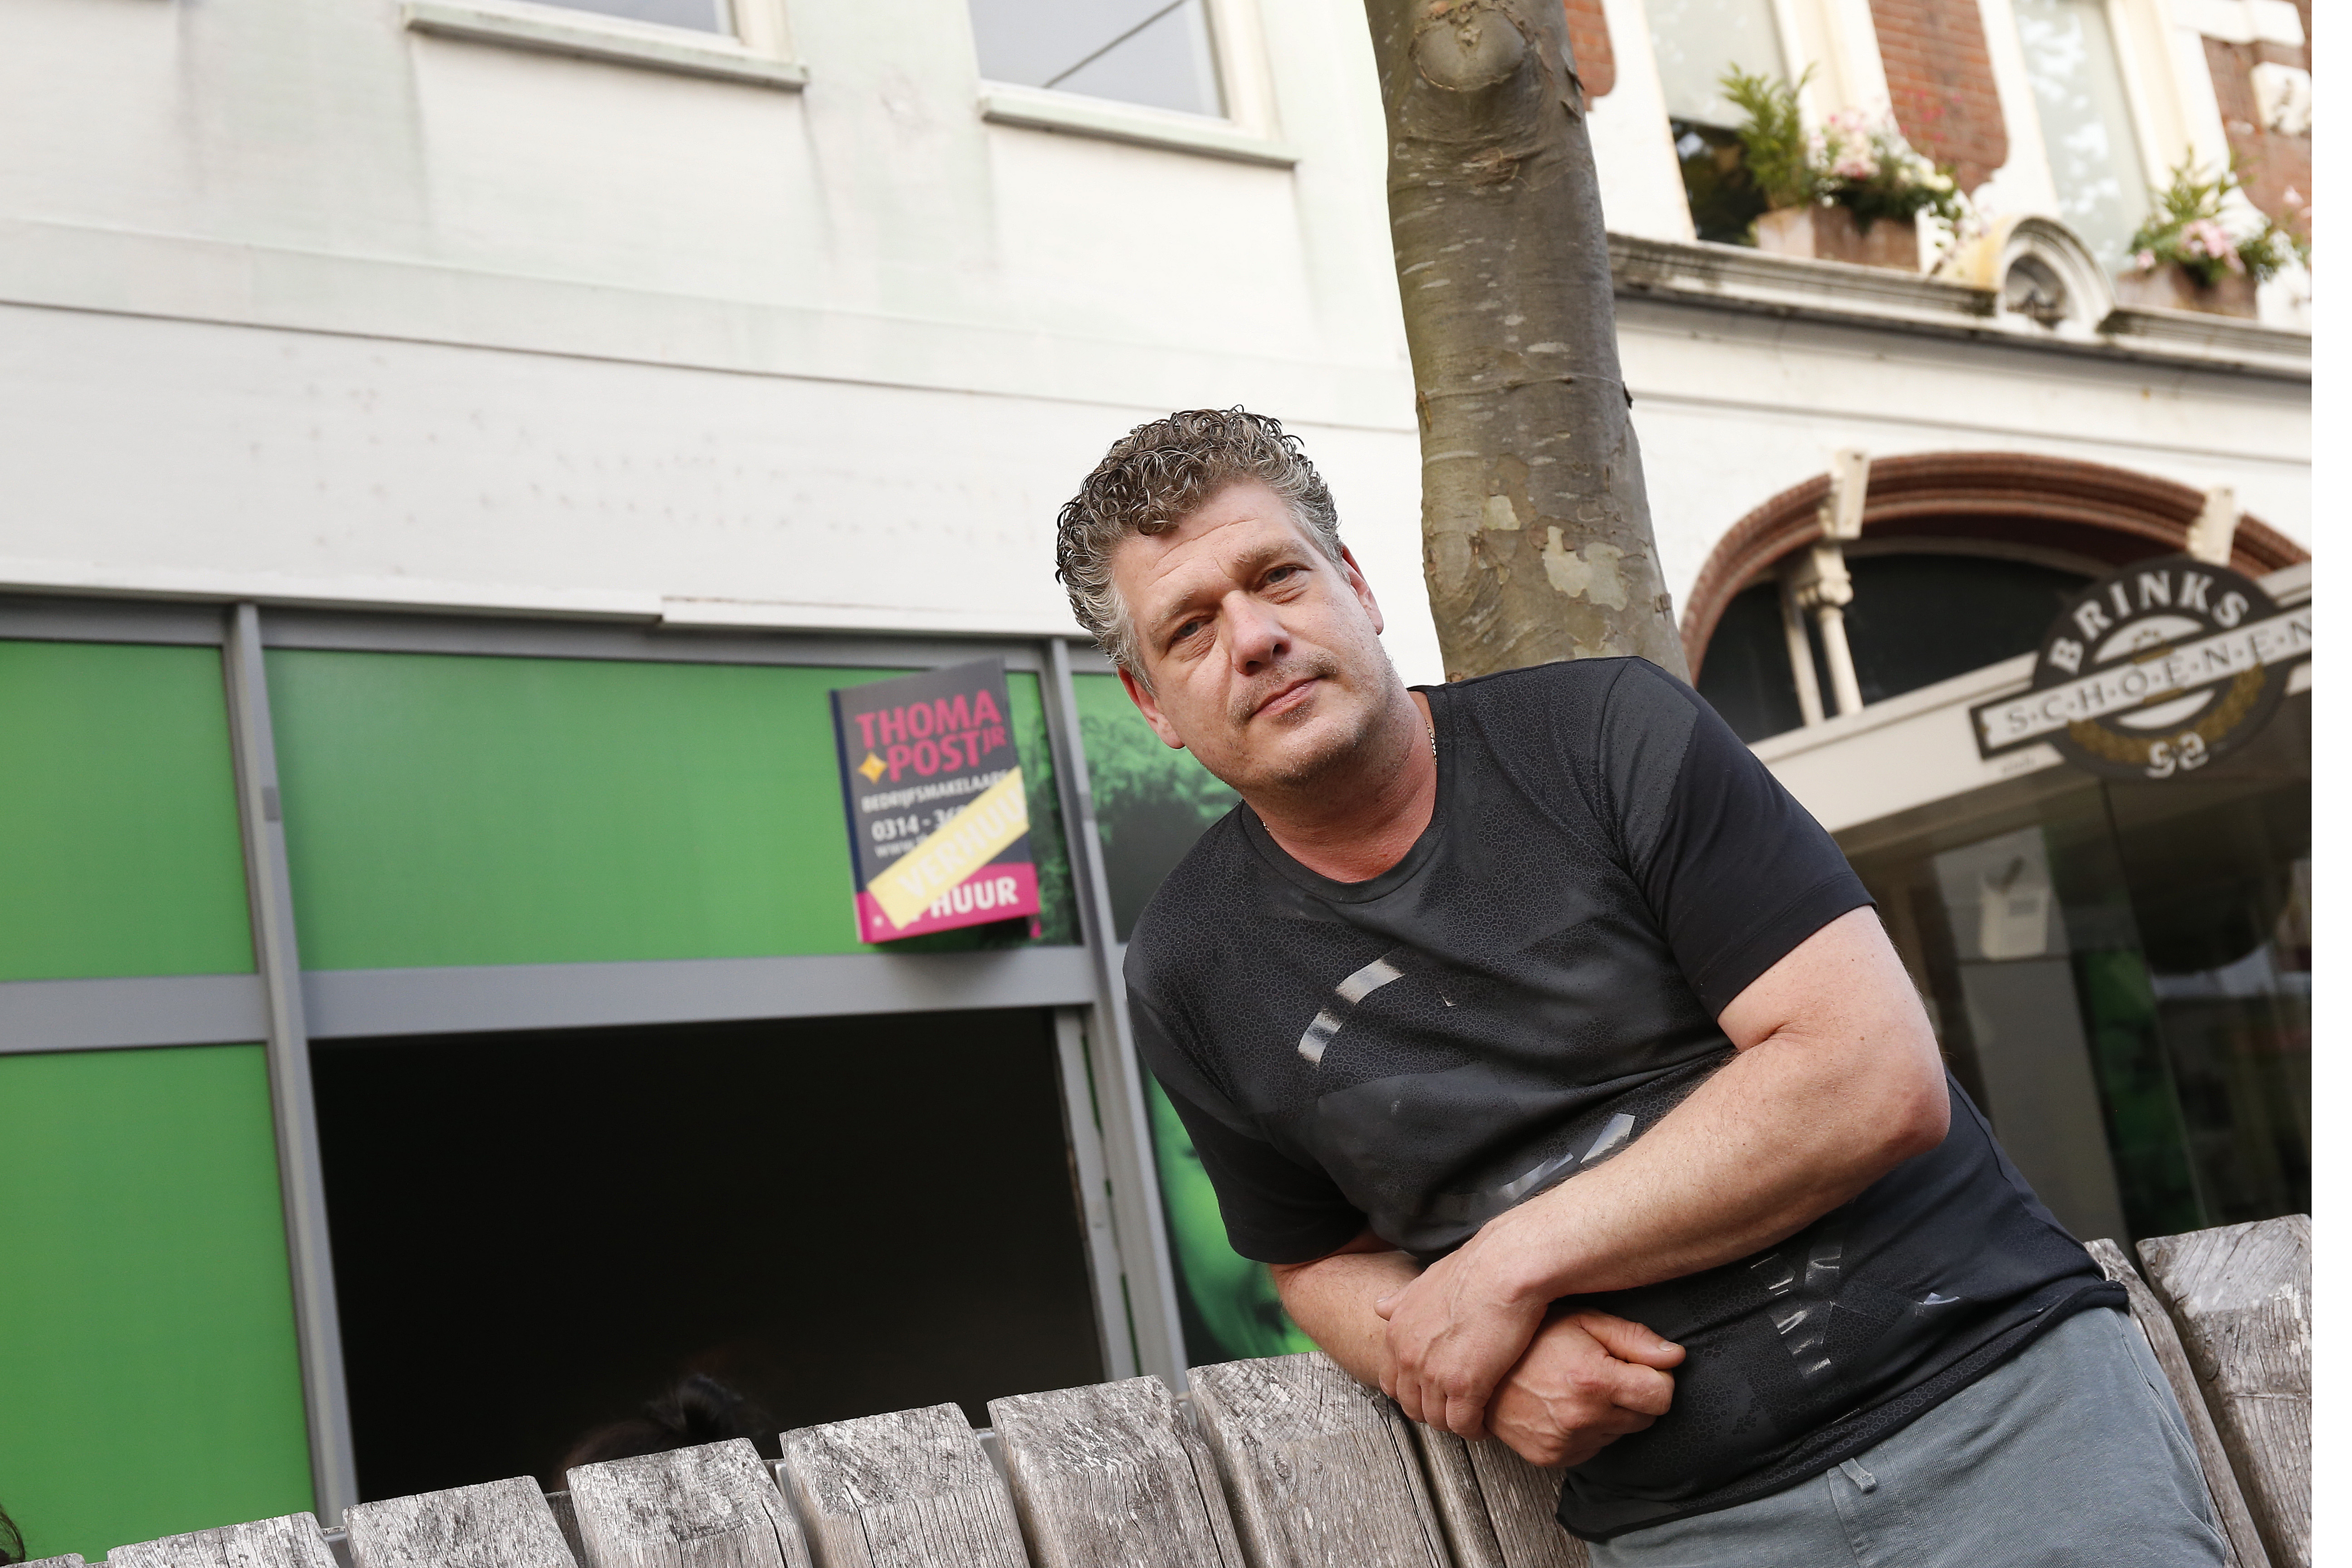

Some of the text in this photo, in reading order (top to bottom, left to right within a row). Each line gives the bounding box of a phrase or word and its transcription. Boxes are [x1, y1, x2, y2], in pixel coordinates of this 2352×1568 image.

[2048, 571, 2249, 674] BRINKS
[855, 689, 1003, 750] THOMA
[886, 725, 1007, 783] POST JR
[871, 814, 919, 841] 0314
[930, 876, 1019, 918] HUUR
